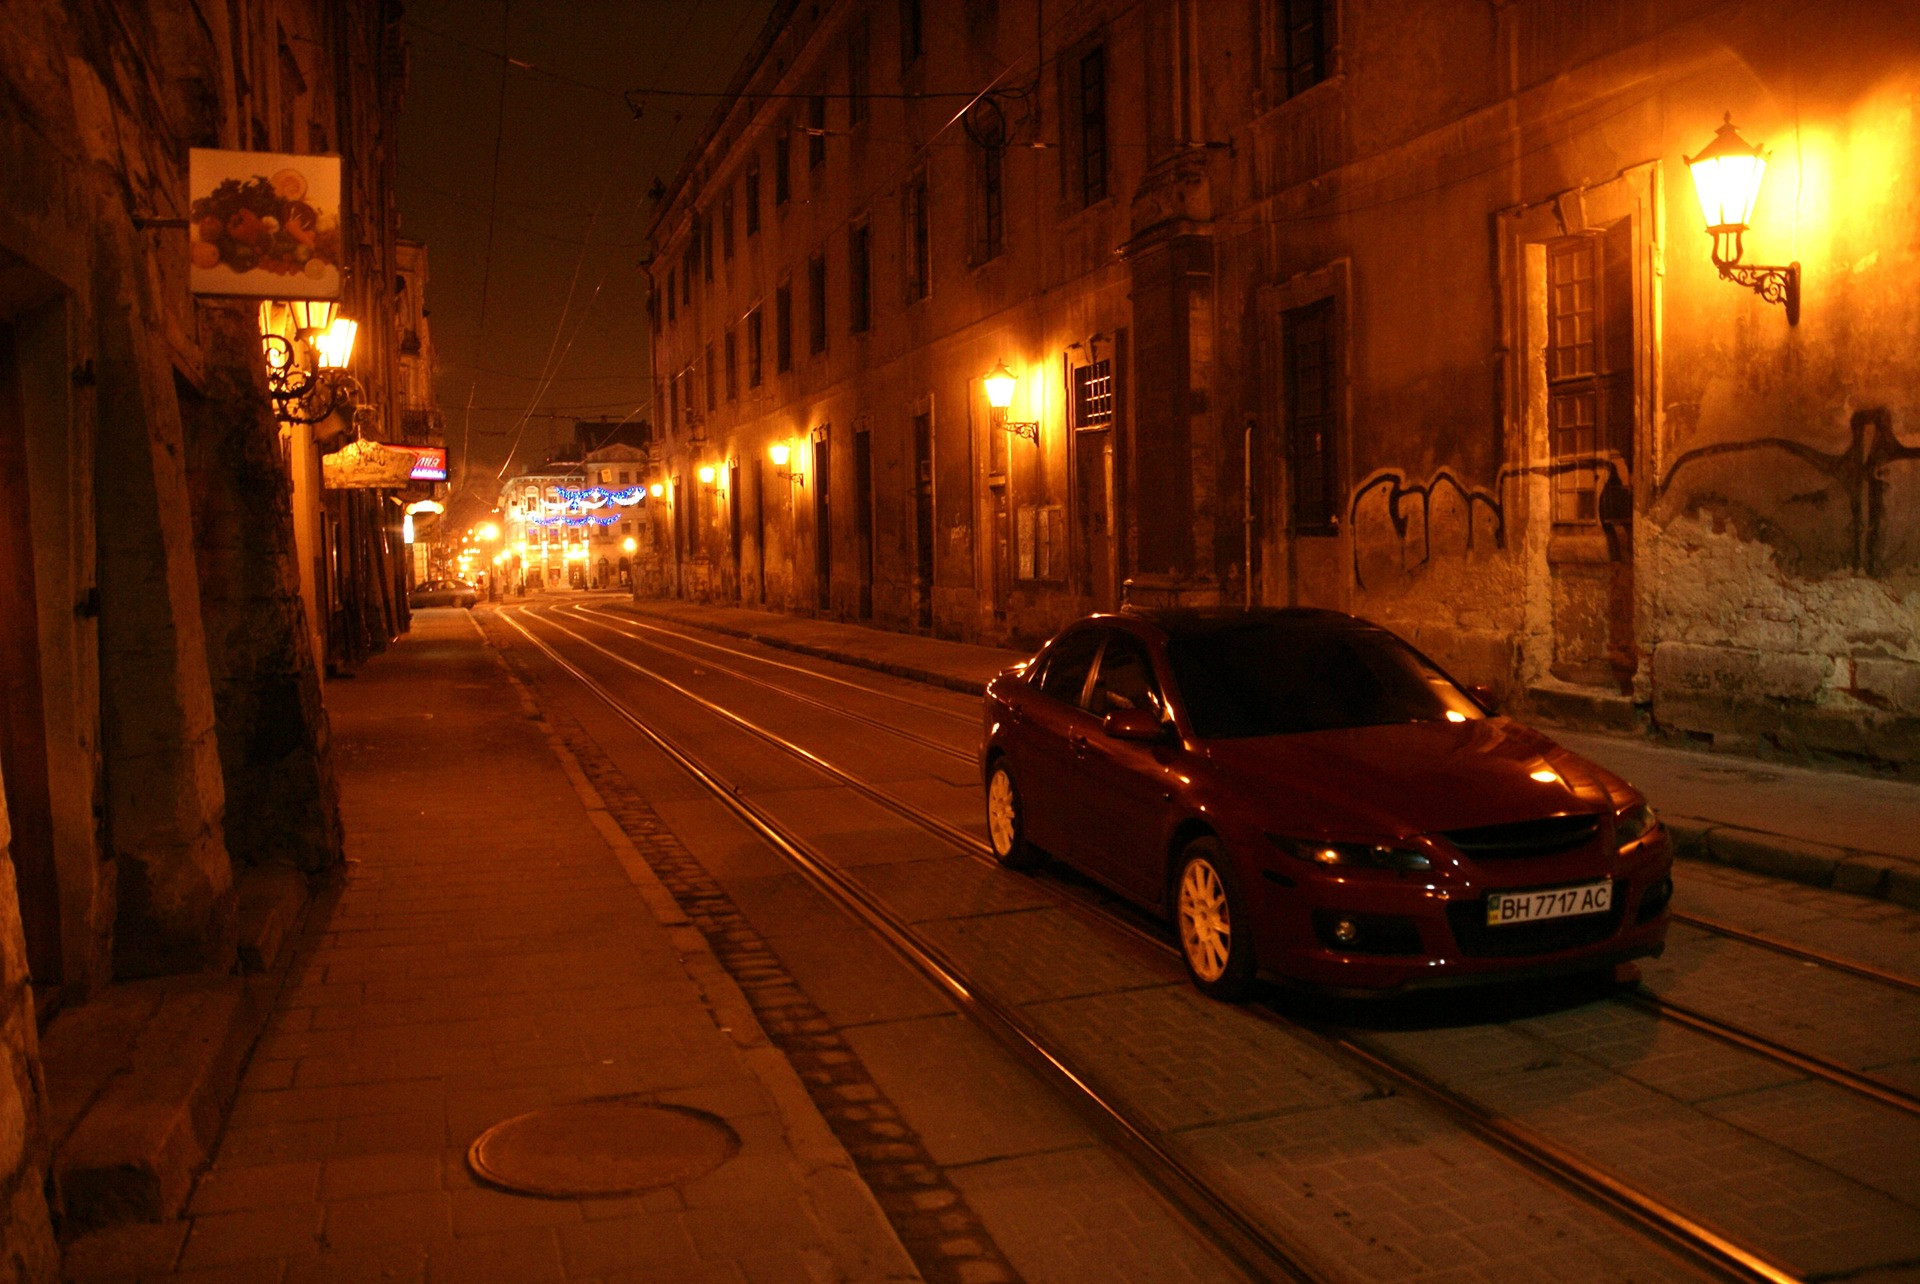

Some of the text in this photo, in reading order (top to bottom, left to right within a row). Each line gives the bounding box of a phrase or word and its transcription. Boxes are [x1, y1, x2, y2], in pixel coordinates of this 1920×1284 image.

[1502, 898, 1530, 919] BH
[1535, 891, 1577, 916] 7717
[1581, 888, 1607, 910] AC
